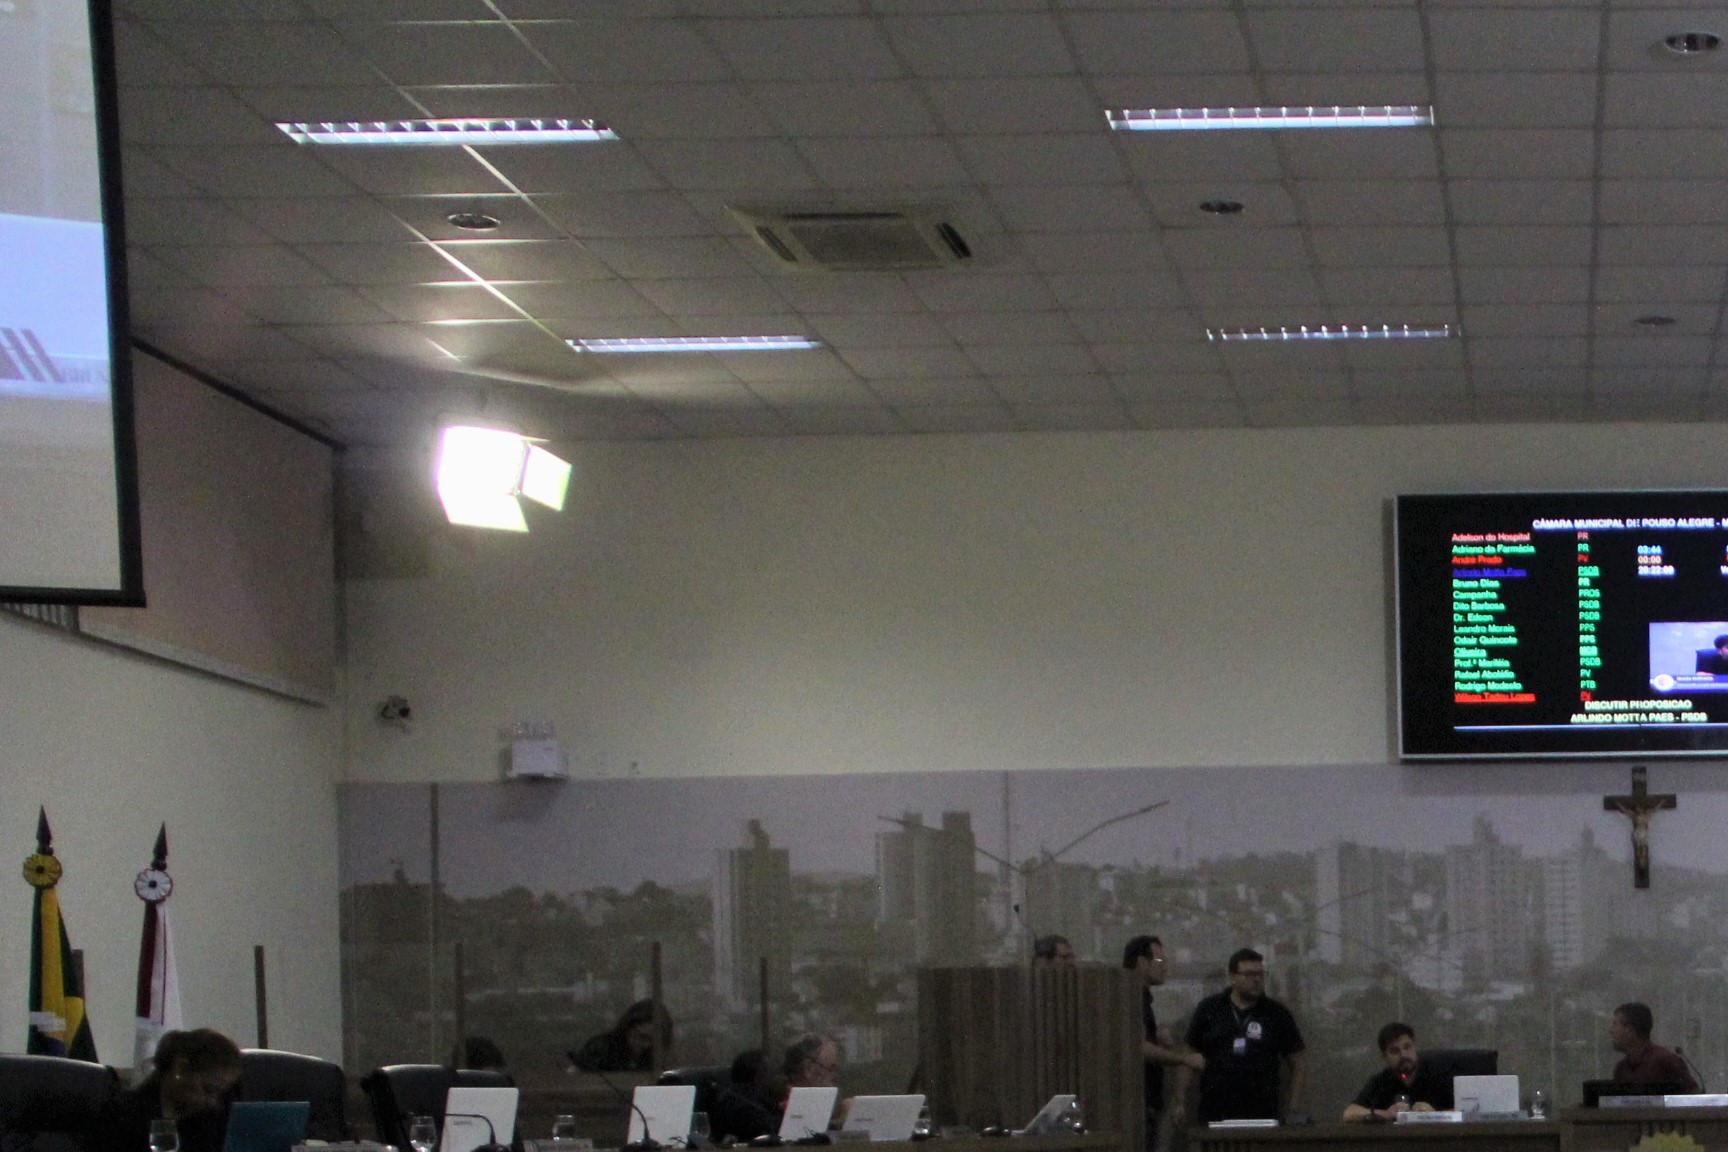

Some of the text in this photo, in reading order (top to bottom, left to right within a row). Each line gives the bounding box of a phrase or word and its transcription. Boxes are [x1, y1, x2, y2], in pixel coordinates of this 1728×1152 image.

[1532, 518, 1573, 528] CÂMARA
[1574, 518, 1624, 528] MUNICIPAL
[1642, 518, 1674, 528] POUSO
[1677, 518, 1714, 528] ALEGRE
[1486, 533, 1496, 542] do
[1498, 532, 1530, 542] Hospital
[1578, 532, 1588, 540] PR
[1452, 545, 1484, 554] Adriano
[1484, 544, 1496, 554] da
[1578, 544, 1589, 552] PR
[1578, 555, 1588, 563] PV
[1638, 555, 1662, 564] 00:00
[1578, 566, 1600, 576] PSDB
[1452, 579, 1500, 588] Bruno Dias
[1578, 578, 1590, 586] PR
[1579, 589, 1600, 598] PROS
[1579, 600, 1600, 609] PSDB
[1454, 613, 1494, 622] Dr. Edson
[1579, 612, 1600, 620] PSDB
[1454, 624, 1486, 633] Leandro
[1580, 624, 1596, 632] PPS
[1580, 635, 1596, 644] PPS
[1580, 658, 1601, 666] PSDB
[1580, 669, 1591, 678] PV
[1455, 682, 1486, 692] Rodrigo
[1581, 680, 1596, 689] PTB
[1585, 701, 1628, 710] DISCUTIR
[1571, 714, 1612, 722] ARLINDO
[1614, 714, 1647, 722] MOTTA
[1649, 713, 1674, 722] PAES
[1682, 713, 1708, 722] PSDB
